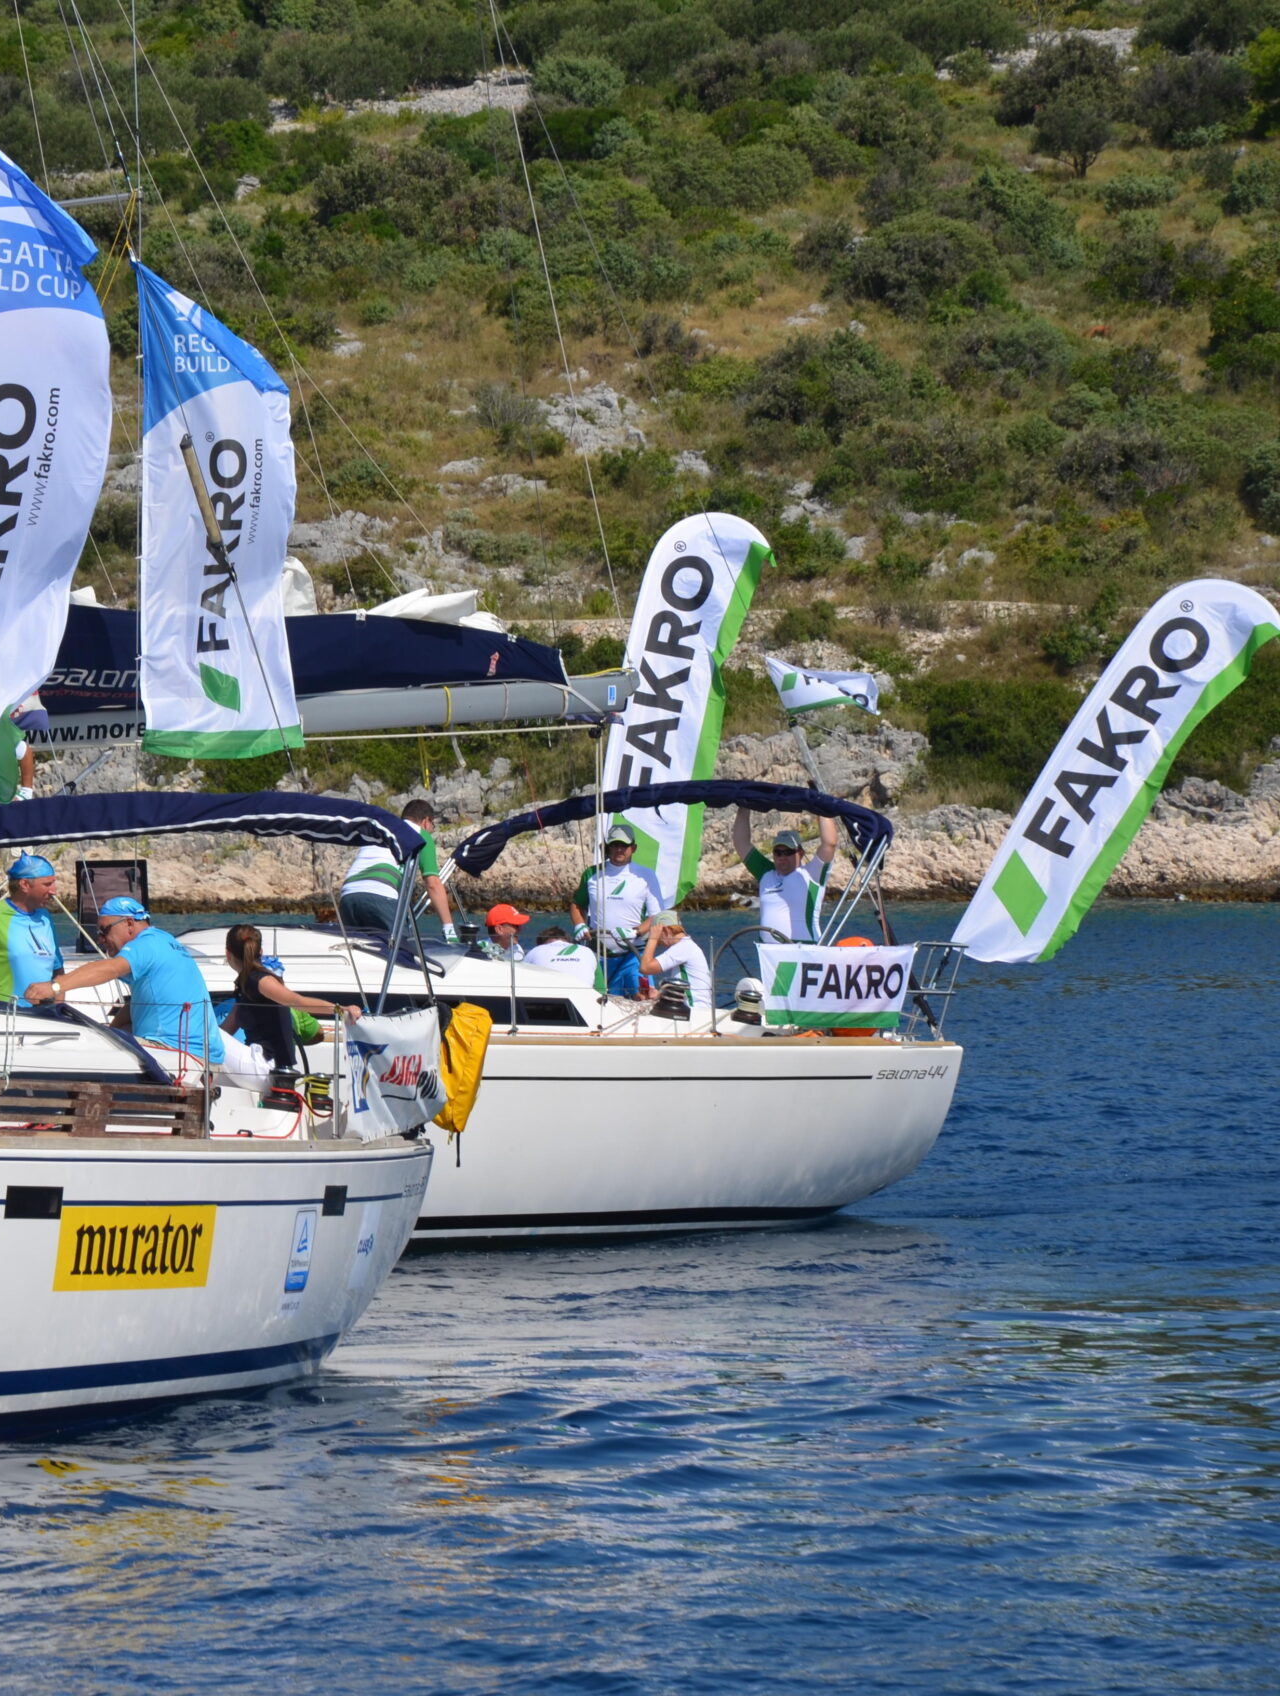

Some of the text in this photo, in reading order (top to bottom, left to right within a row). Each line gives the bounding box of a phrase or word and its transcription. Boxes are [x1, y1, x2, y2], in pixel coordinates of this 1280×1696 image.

[36, 275, 81, 300] CUP
[175, 356, 230, 373] BUILD
[27, 387, 61, 526] www.fakro.com
[218, 438, 264, 545] www.fakro.com
[196, 438, 248, 653] FAKRO
[617, 556, 714, 787] FAKRO
[1022, 616, 1210, 859] FAKRO
[799, 962, 904, 1000] FAKRO
[70, 1214, 203, 1277] murator
